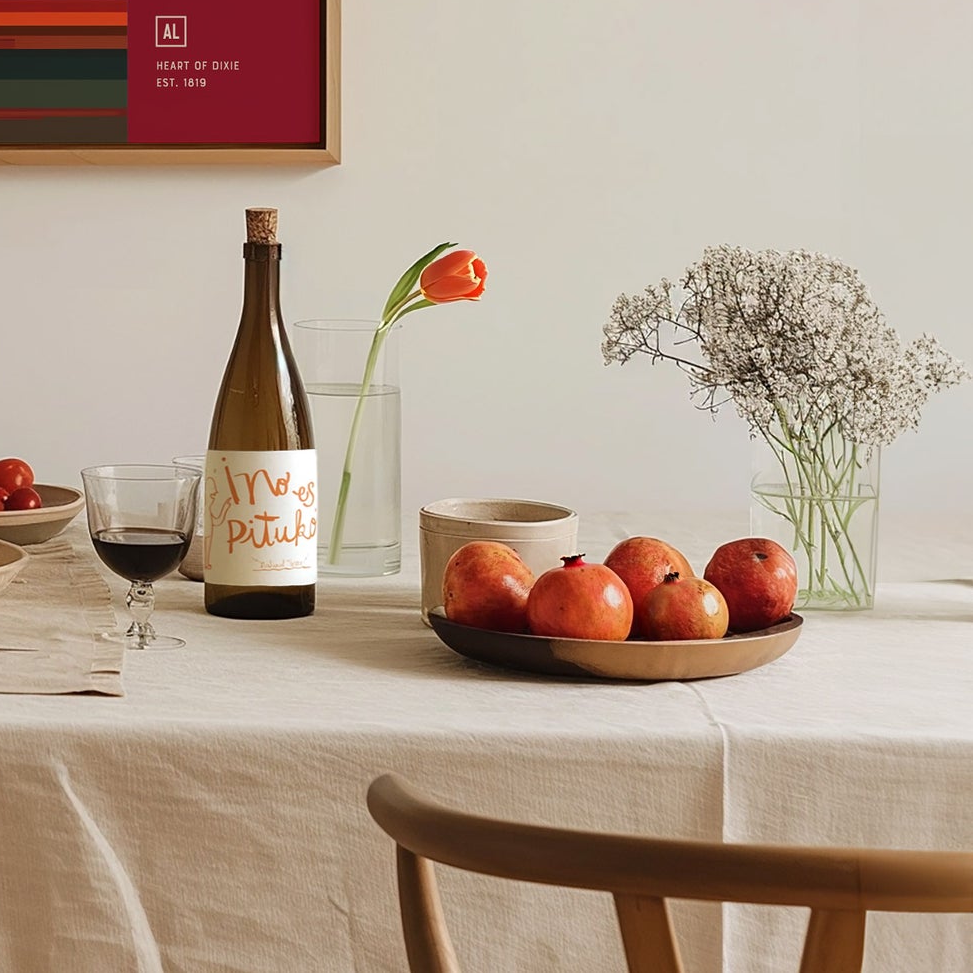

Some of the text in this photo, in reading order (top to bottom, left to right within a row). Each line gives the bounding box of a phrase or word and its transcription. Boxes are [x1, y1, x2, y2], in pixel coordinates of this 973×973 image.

[163, 23, 180, 40] AL
[156, 61, 240, 70] HEART OF DIXIE
[156, 78, 207, 87] EST. 1819
[292, 481, 315, 507] es
